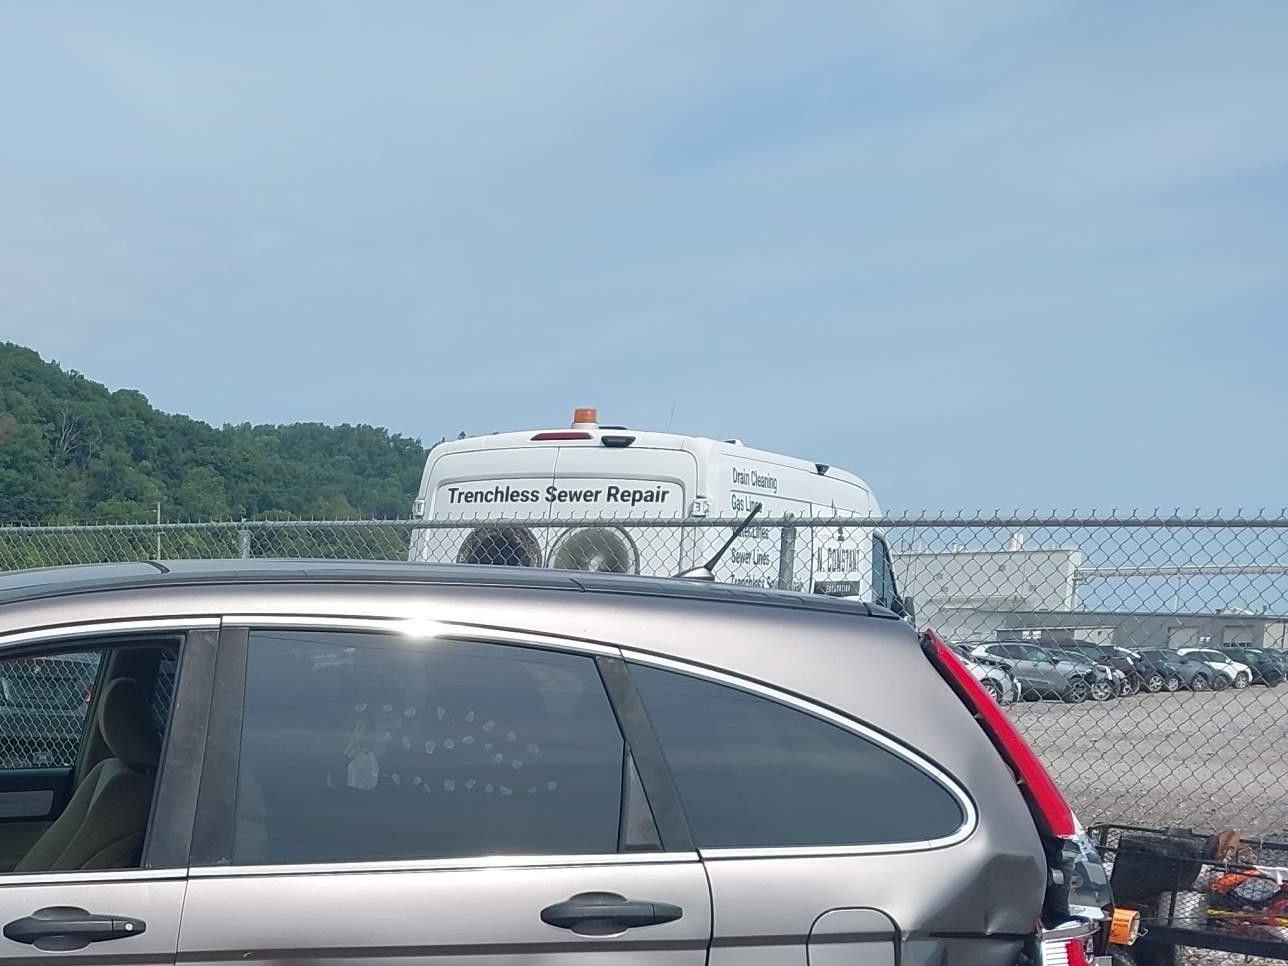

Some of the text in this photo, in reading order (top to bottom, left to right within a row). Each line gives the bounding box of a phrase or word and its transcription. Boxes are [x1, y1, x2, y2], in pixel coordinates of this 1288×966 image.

[732, 467, 778, 494] Drain Cleaning
[448, 486, 670, 506] Trenchless Sewer Repair
[731, 494, 745, 511] Gas
[731, 547, 770, 566] Sewer Lines
